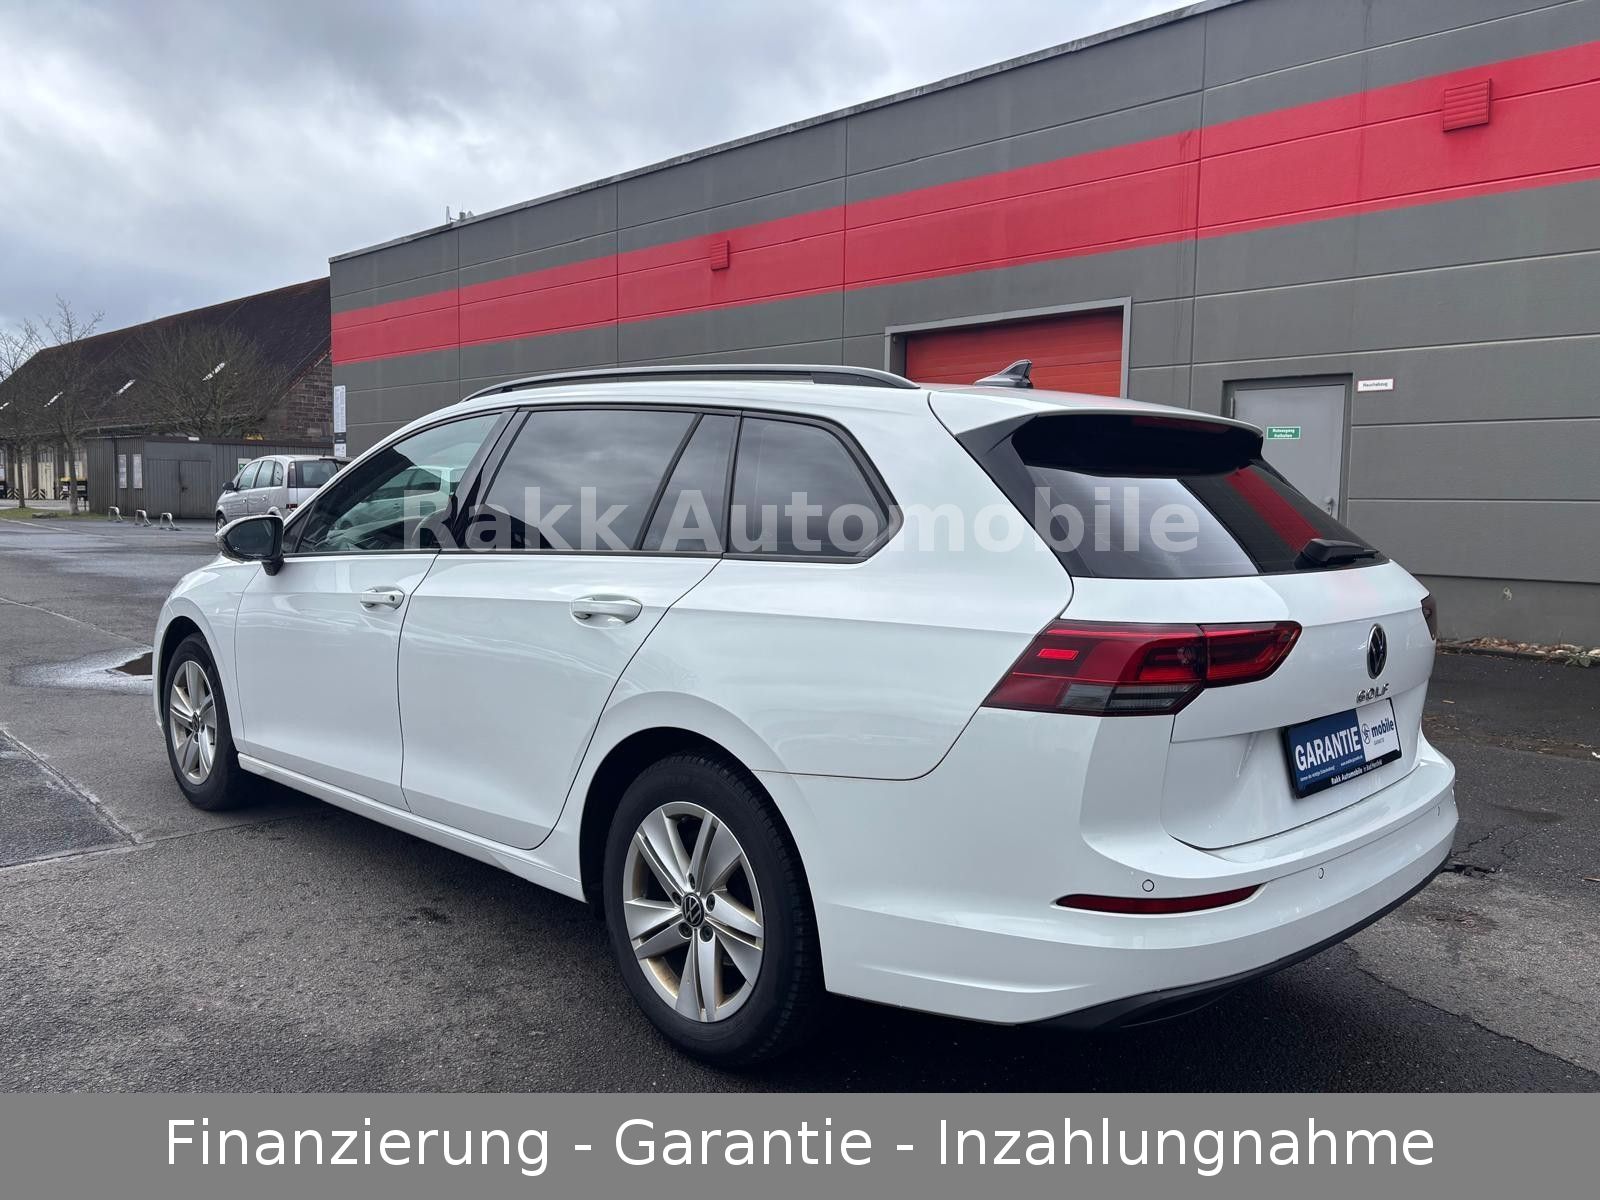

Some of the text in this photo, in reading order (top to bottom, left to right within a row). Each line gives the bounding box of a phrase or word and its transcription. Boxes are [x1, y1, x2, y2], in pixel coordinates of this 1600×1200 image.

[1356, 683, 1389, 703] GOLF
[1371, 717, 1394, 737] mobile
[1295, 726, 1361, 771] GARANTIE
[1341, 767, 1363, 781] Automobile
